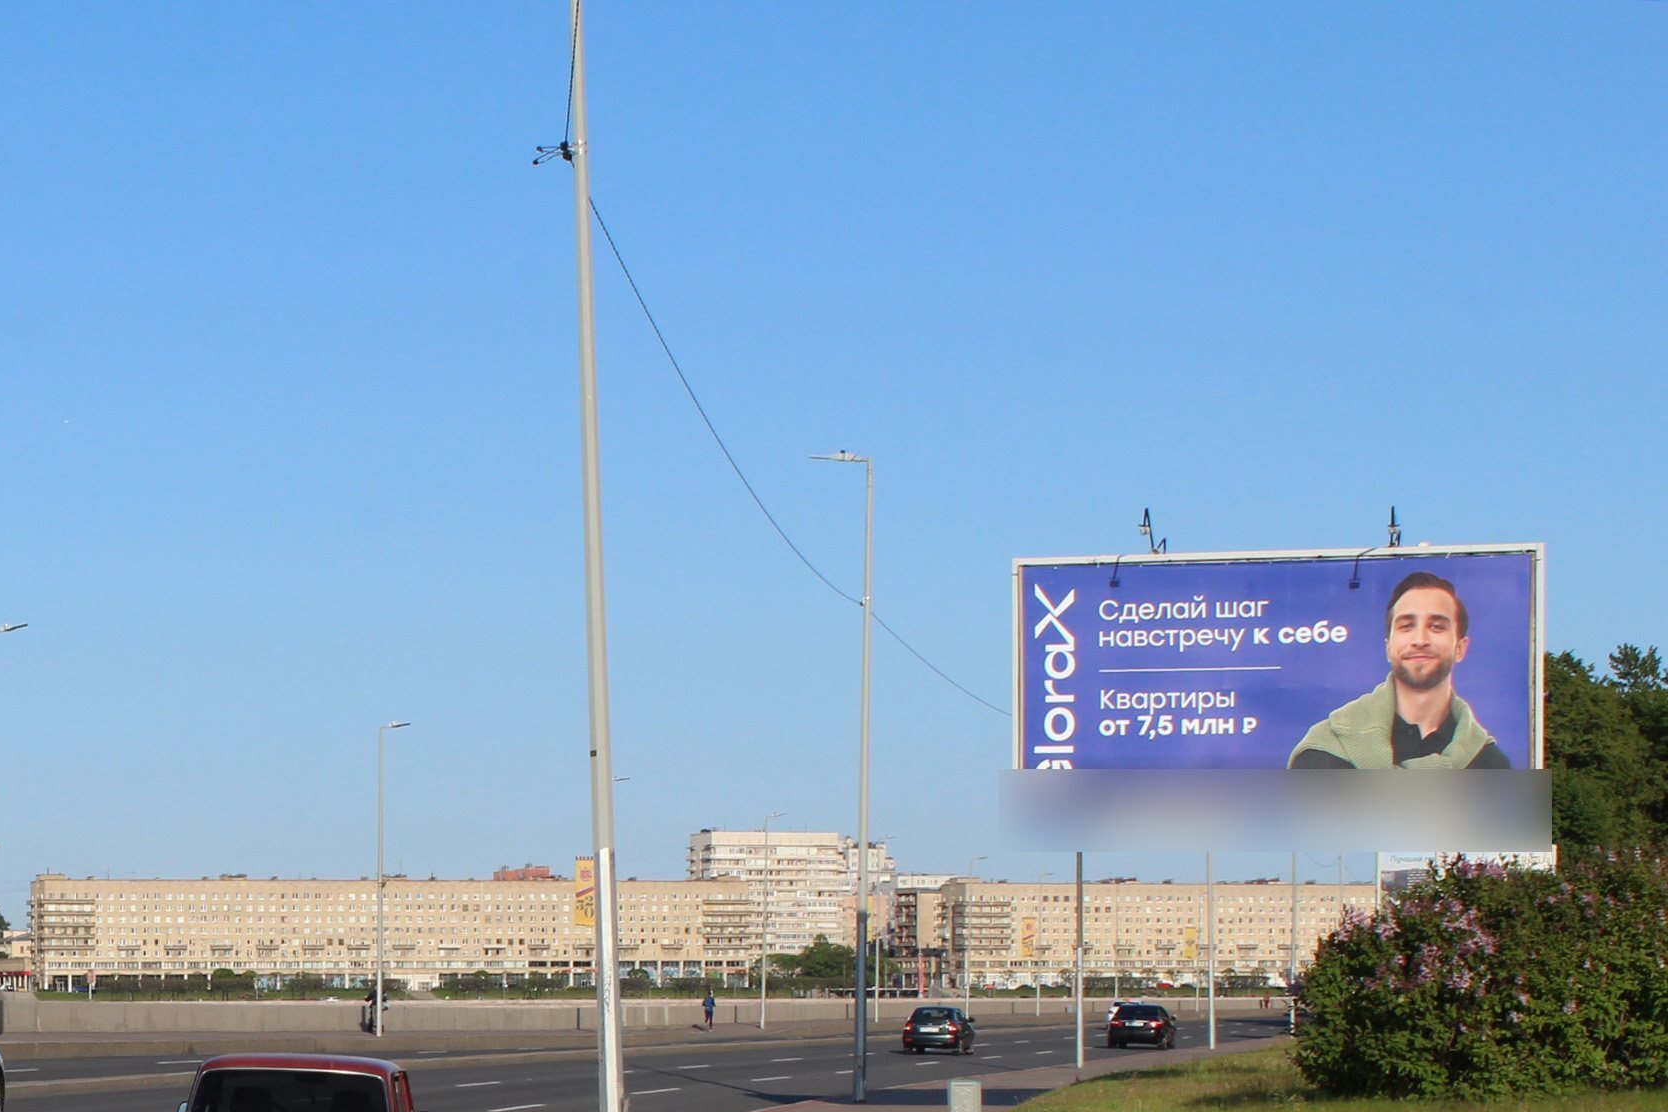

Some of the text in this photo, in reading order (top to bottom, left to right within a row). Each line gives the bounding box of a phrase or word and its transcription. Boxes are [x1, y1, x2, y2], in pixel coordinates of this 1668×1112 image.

[1098, 595, 1269, 624] Сделай шаг
[1098, 620, 1348, 652] навстречу к себе
[1034, 583, 1076, 769] loraX
[1099, 689, 1235, 714] Квартиры
[1099, 719, 1130, 737] от
[1137, 715, 1173, 740] 7,5
[1182, 717, 1234, 736] млн
